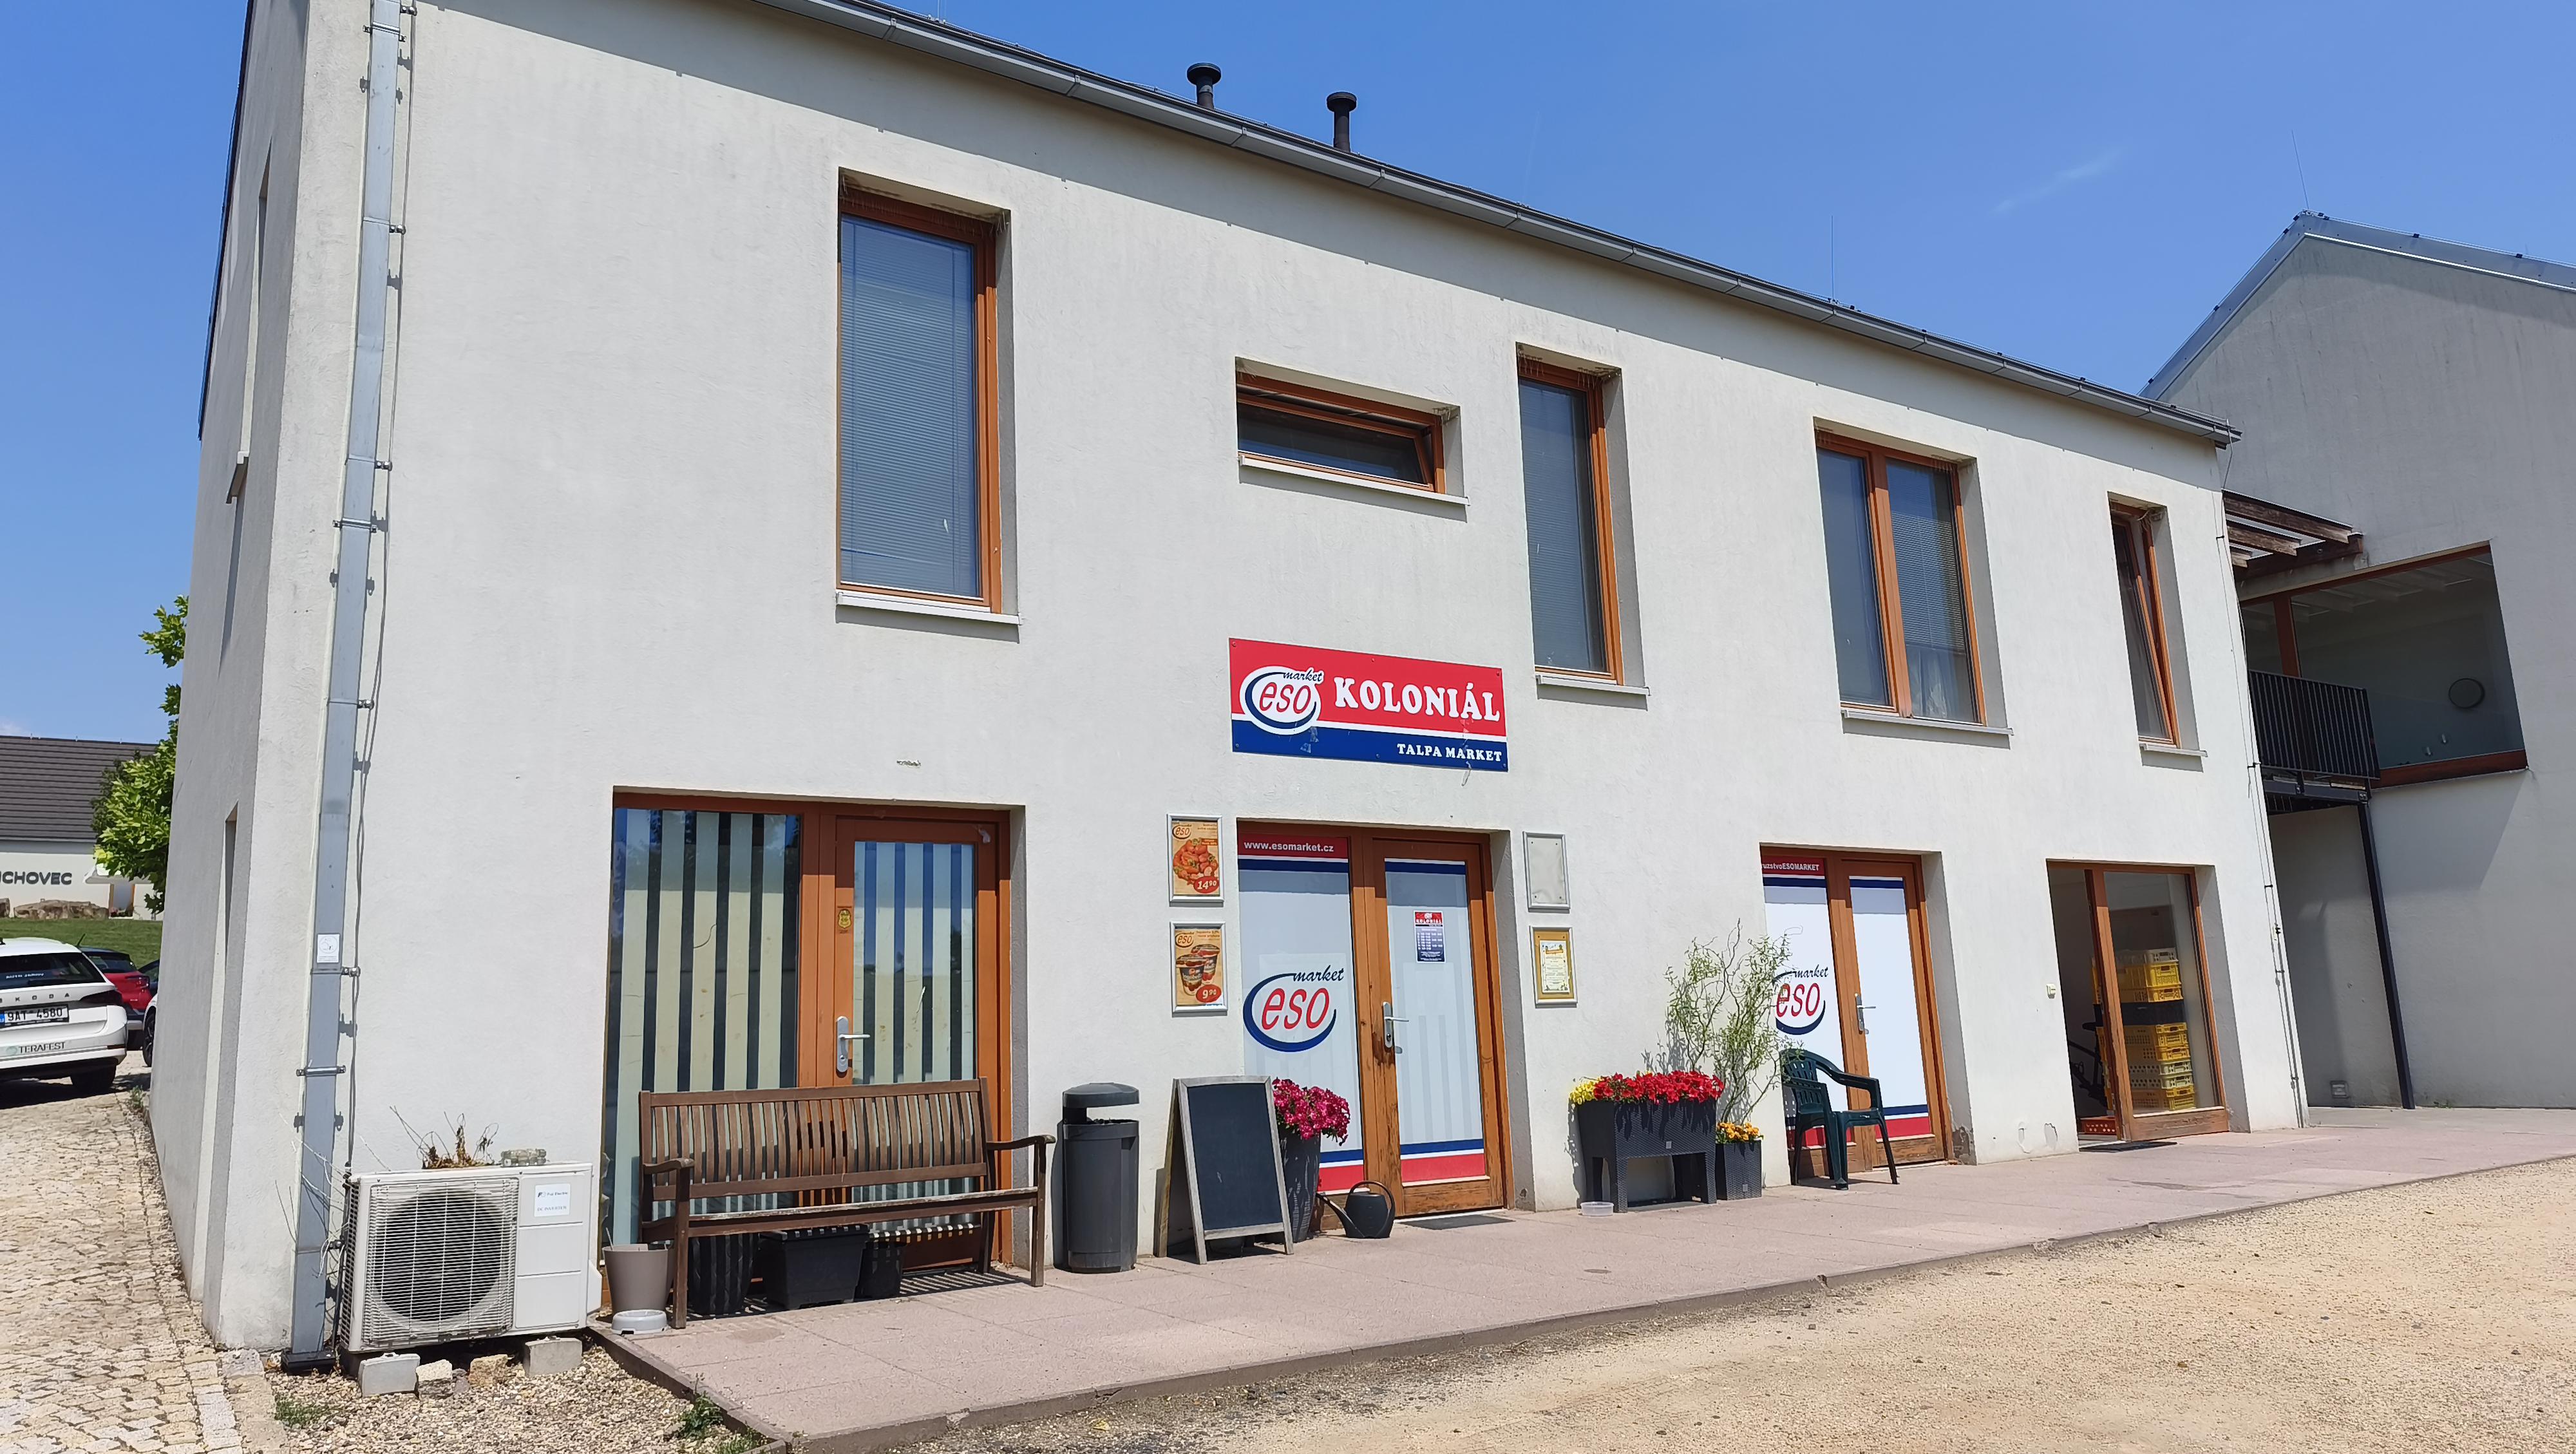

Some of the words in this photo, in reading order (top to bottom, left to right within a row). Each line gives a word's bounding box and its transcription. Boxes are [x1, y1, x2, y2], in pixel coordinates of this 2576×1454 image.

[1283, 667, 1323, 682] market
[1260, 681, 1311, 714] eso
[1334, 676, 1500, 721] KOLONIÁL
[1397, 743, 1443, 758] TALPA
[1445, 748, 1502, 762] MARKET
[1244, 841, 1334, 852] www.esomarket.cz
[0, 871, 72, 885] CHOVEC
[1293, 965, 1344, 981] market
[1794, 965, 1829, 978] market
[1776, 983, 1821, 1017] eso
[7, 1011, 26, 1021] 9AT
[37, 1007, 62, 1019] 4580
[1261, 987, 1330, 1030] eso
[19, 1041, 65, 1053] TERAFEST
